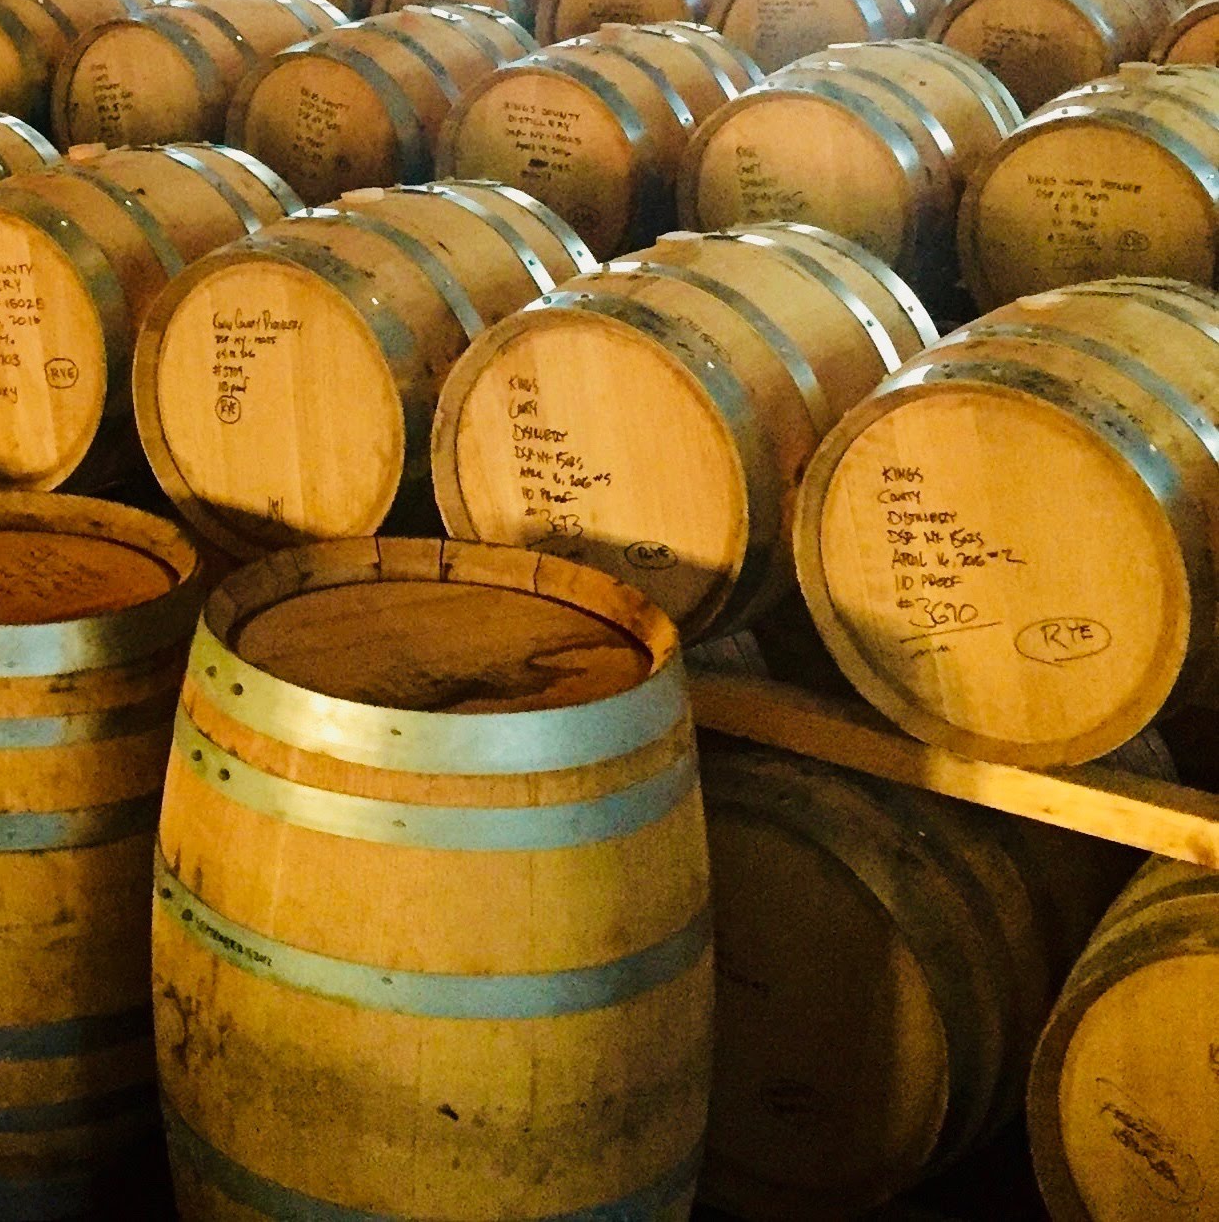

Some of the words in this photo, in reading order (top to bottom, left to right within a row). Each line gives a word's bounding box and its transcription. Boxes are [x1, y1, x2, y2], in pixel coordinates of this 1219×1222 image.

[8, 314, 42, 327] 2016
[50, 366, 75, 382] RYE
[882, 466, 924, 484] KINGS
[896, 597, 978, 628] #3690
[1040, 623, 1094, 650] RYE
